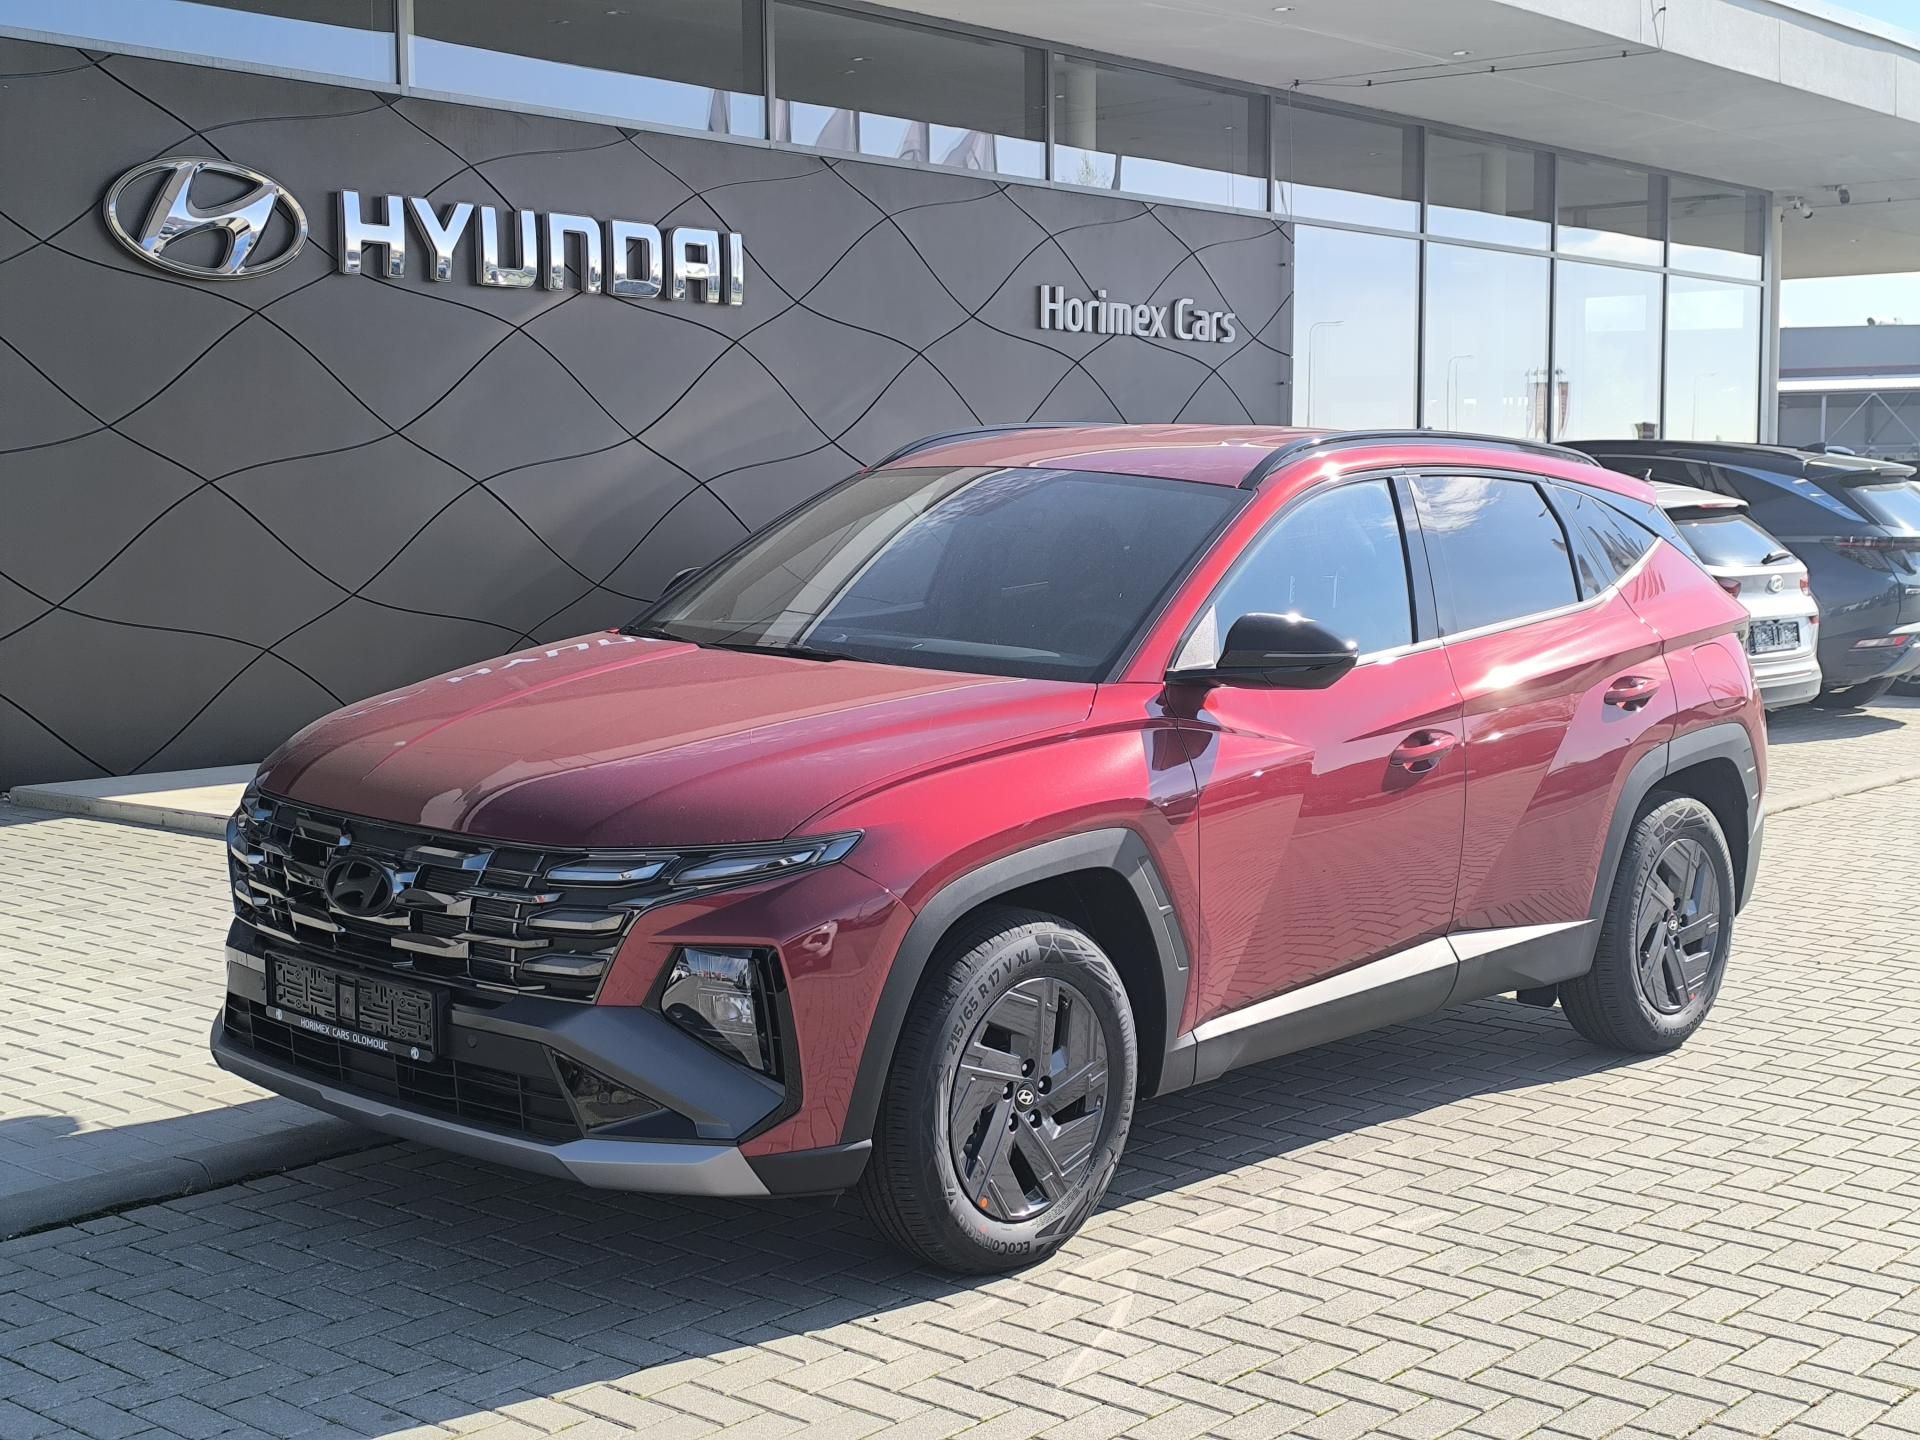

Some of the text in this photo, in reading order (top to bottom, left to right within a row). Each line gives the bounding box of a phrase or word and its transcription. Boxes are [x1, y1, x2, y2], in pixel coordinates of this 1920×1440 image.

[337, 188, 744, 306] HYUNDAI
[1039, 284, 1236, 343] Horimex Cars
[300, 1018, 389, 1051] HORIMEX CARS OLOMOUC
[947, 949, 1033, 1056] 215/65 R 17 V XL
